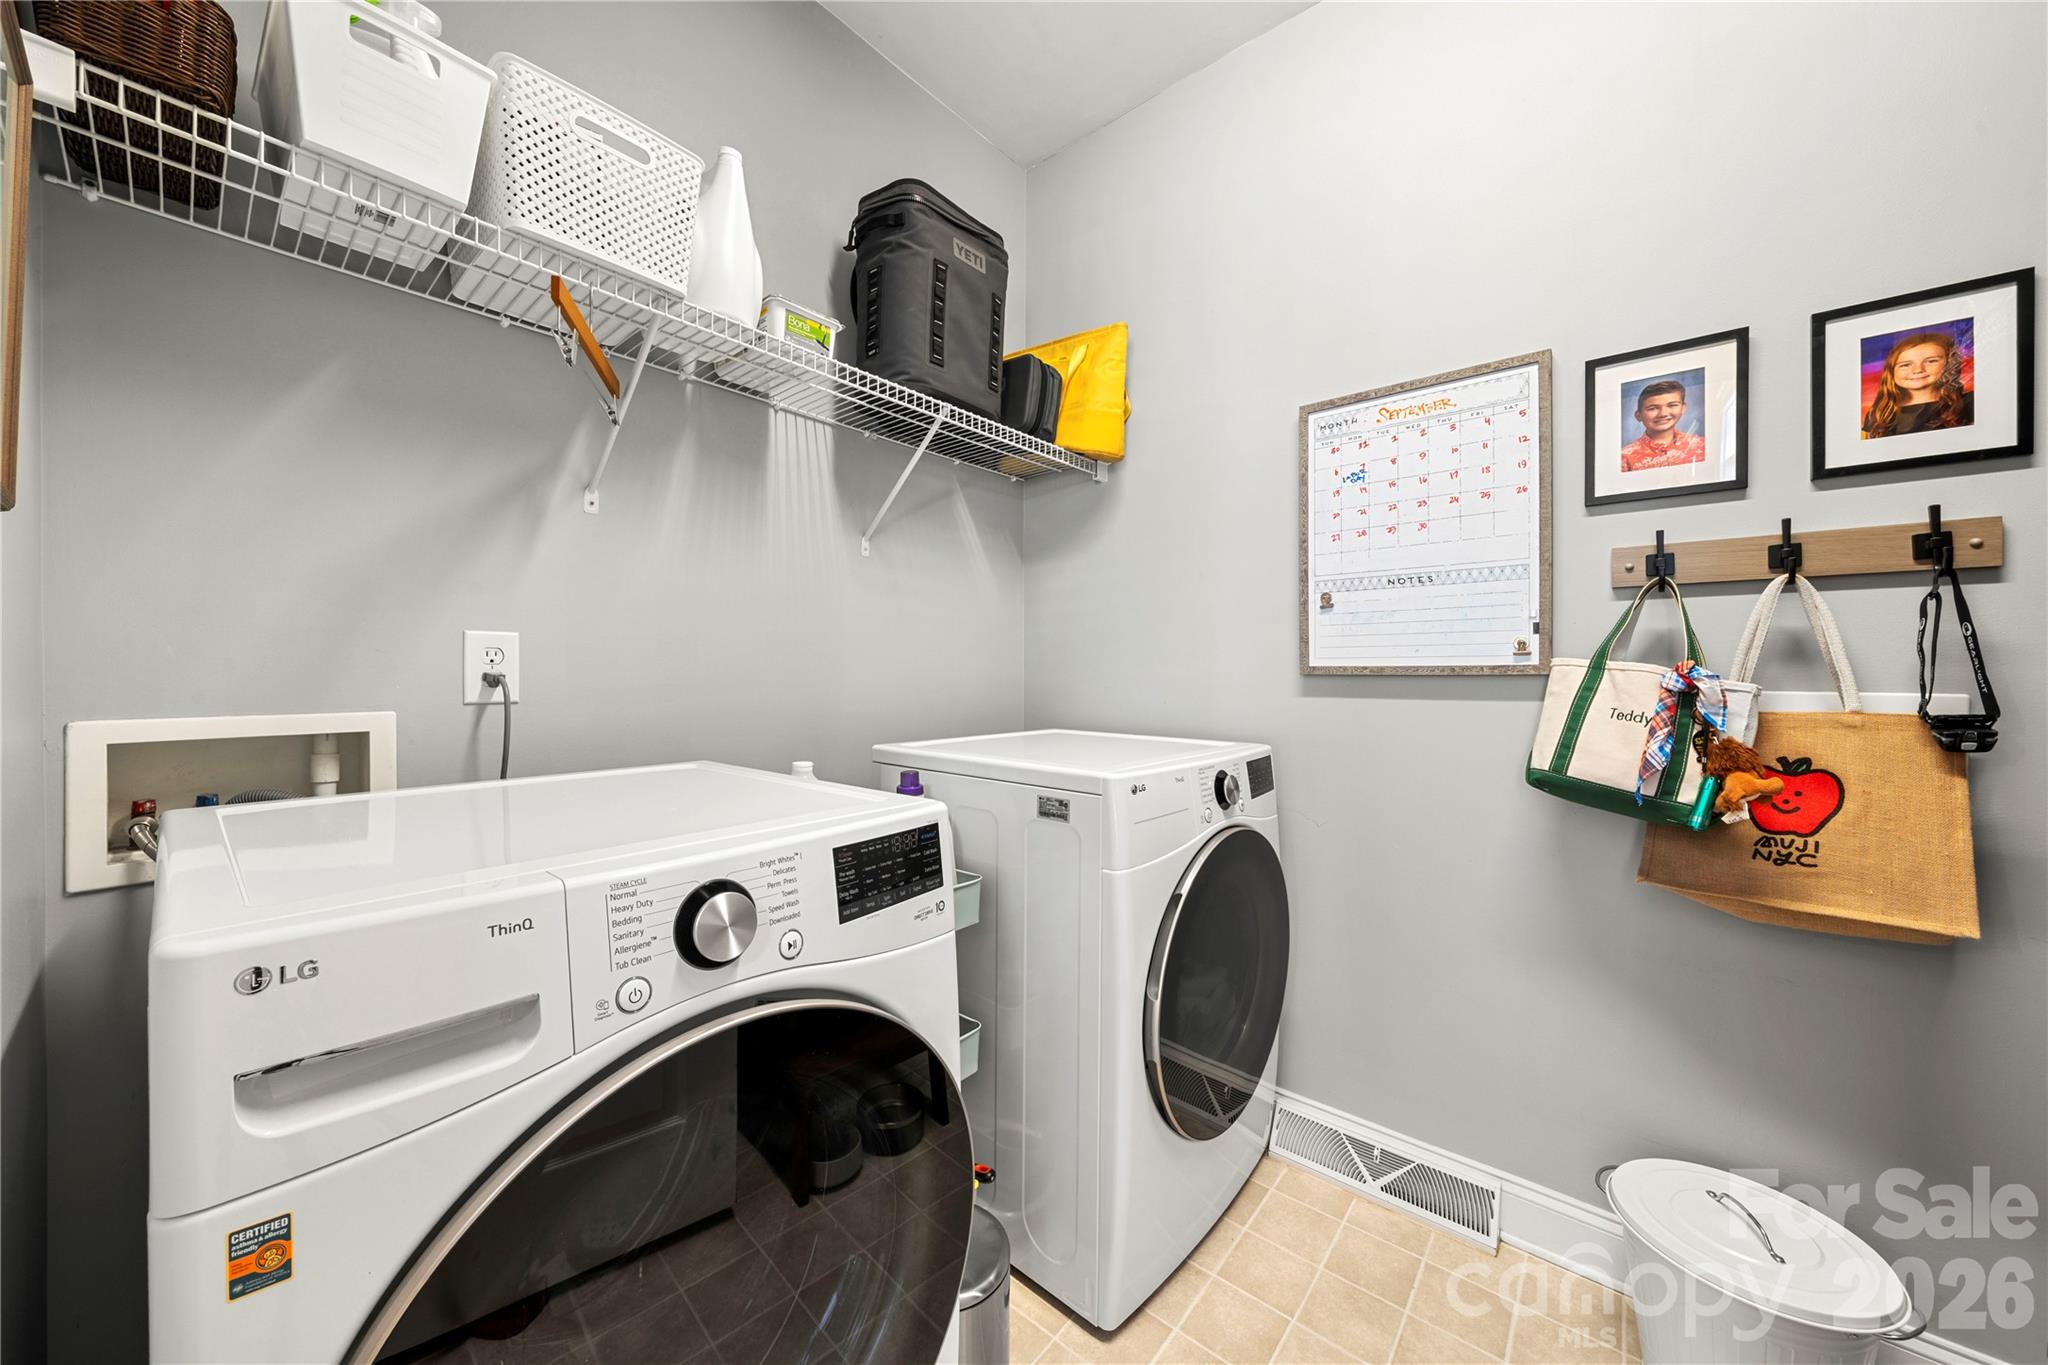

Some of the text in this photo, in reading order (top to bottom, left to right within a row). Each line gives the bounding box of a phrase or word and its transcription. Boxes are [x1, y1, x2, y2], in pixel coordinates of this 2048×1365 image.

[956, 242, 982, 269] YETI
[788, 315, 810, 332] Bona
[1376, 398, 1456, 422] SEPTEMBER
[1320, 418, 1358, 431] MONTH
[1484, 417, 1490, 425] 4
[1419, 452, 1426, 460] 9
[1419, 476, 1427, 484] 16
[1450, 471, 1459, 479] 17
[1518, 460, 1527, 468] 19
[1480, 491, 1491, 499] 25
[1516, 485, 1528, 494] 26
[1331, 534, 1340, 542] 27
[1388, 576, 1433, 585] NOTES
[1968, 636, 1988, 693] GEARLIGHT
[1610, 708, 1653, 727] Teddy
[1138, 784, 1146, 792] LG
[1753, 836, 1820, 854] MUJI
[760, 860, 776, 868] Bright
[1752, 848, 1818, 868] NYC
[773, 866, 796, 876] Delicates
[610, 878, 647, 890] STEAM CYCLE
[610, 889, 638, 901] Normal
[782, 888, 799, 897] Towels
[611, 898, 654, 914] Heavy Duty
[768, 900, 800, 914] Speed Wash
[612, 915, 642, 928] Bedding
[769, 911, 801, 926] Downloaded
[487, 918, 534, 938] ThinQ
[613, 928, 644, 942] Sanitary
[616, 955, 652, 970] Tub Clean
[280, 960, 319, 984] LG
[231, 1217, 288, 1244] CERTIFIED
